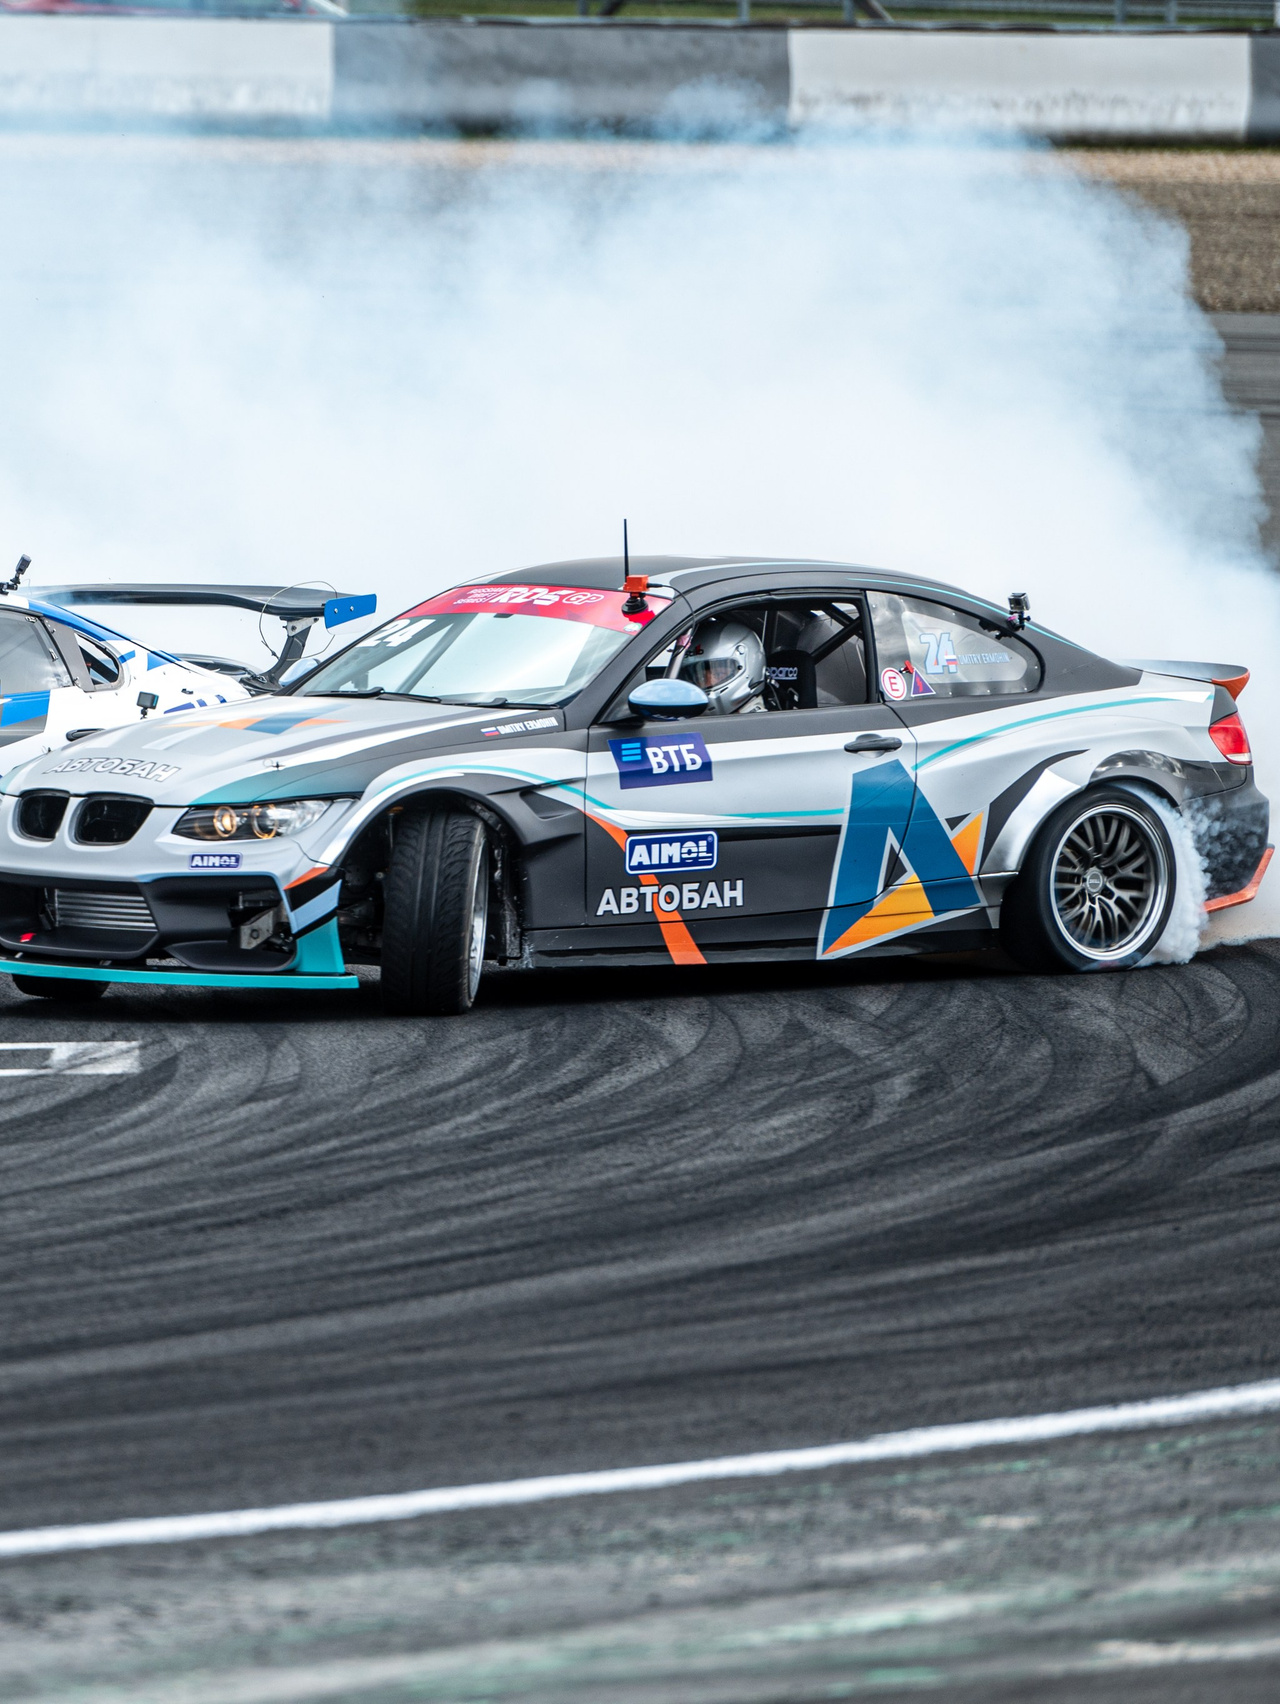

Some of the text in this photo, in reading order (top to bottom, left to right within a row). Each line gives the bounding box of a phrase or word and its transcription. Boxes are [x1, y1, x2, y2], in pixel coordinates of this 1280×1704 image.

[488, 587, 605, 606] RDS GP
[354, 618, 436, 647] 24
[920, 632, 957, 674] 24
[888, 676, 900, 692] E
[42, 757, 182, 783] АВТОБАН
[645, 743, 703, 774] ВТБ
[190, 855, 239, 868] AIMOL
[629, 840, 713, 867] AIMOL
[595, 879, 744, 916] АВТОБАН
